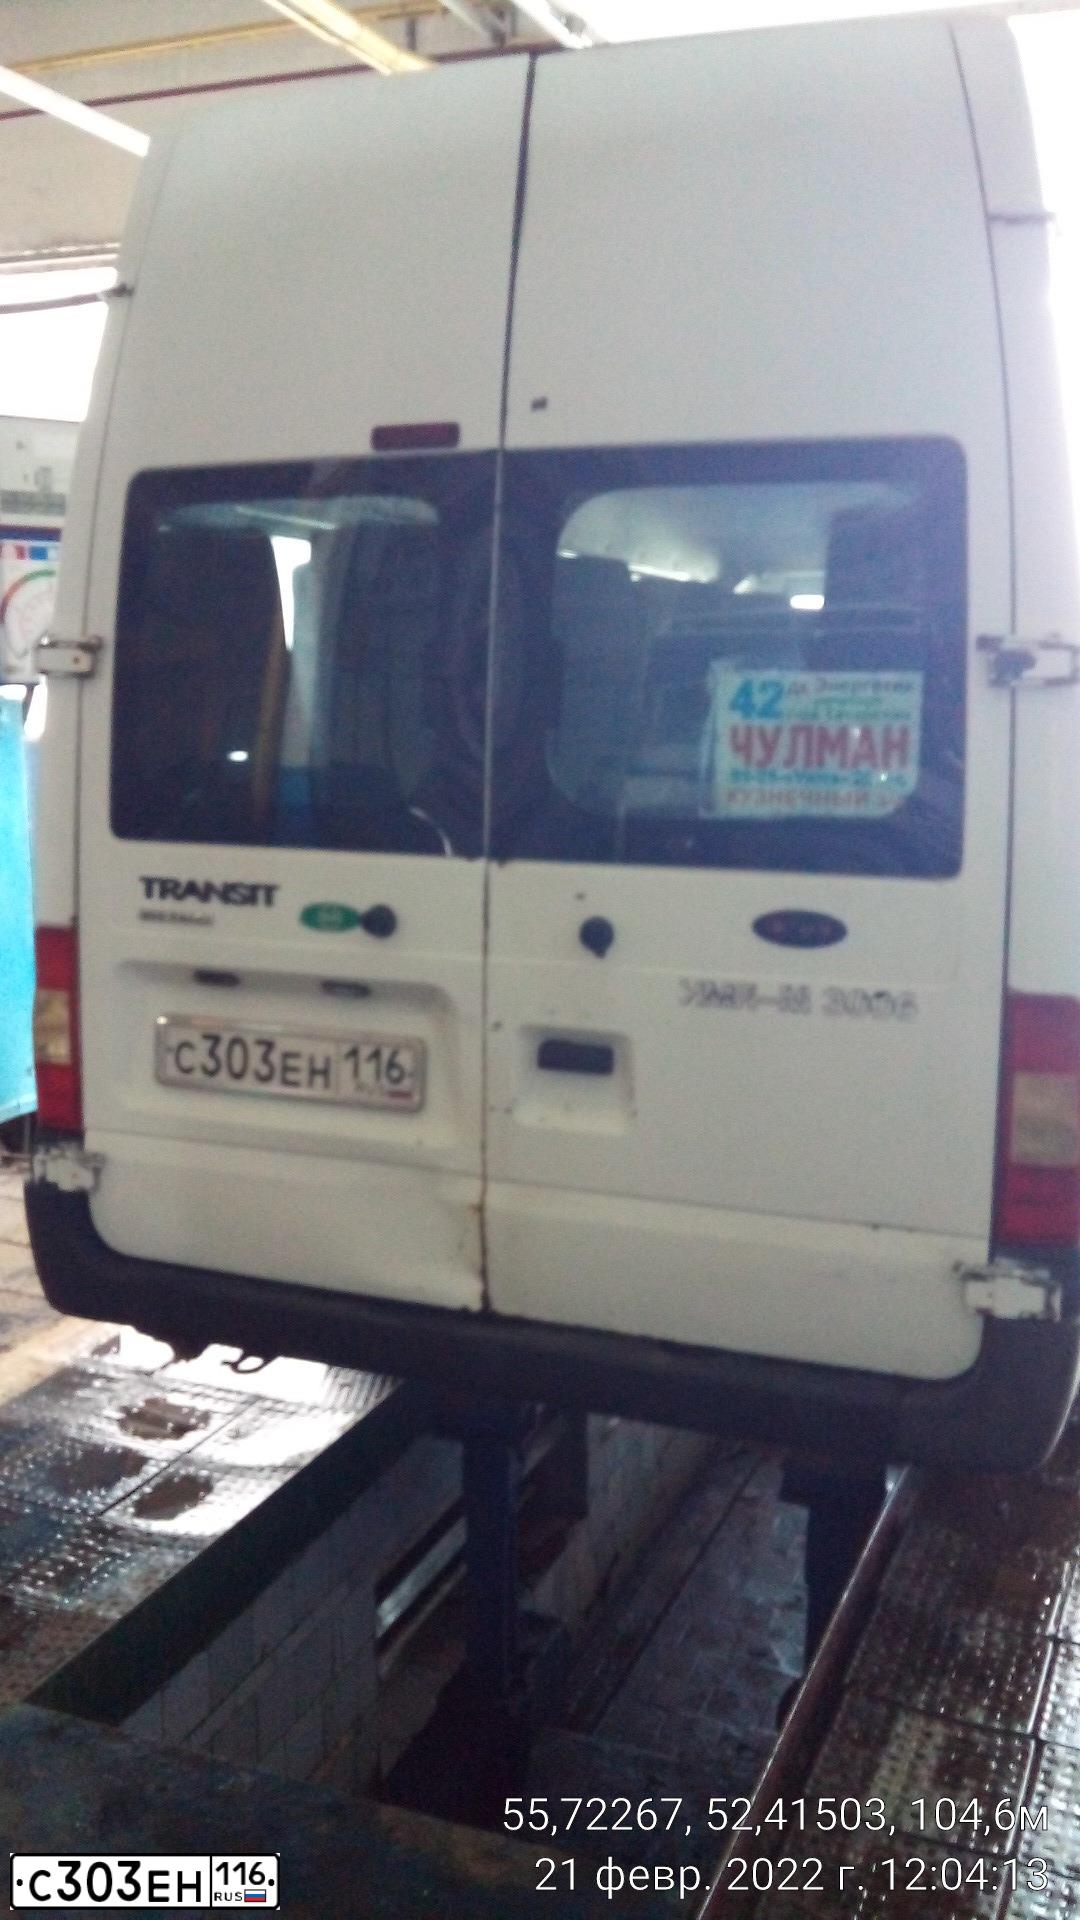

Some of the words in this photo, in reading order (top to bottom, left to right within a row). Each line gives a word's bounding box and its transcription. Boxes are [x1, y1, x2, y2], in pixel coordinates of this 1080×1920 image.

[729, 679, 784, 720] 42
[729, 723, 911, 769] ЧУЛМАН
[140, 876, 279, 907] TRANSIT
[344, 1046, 406, 1086] 116
